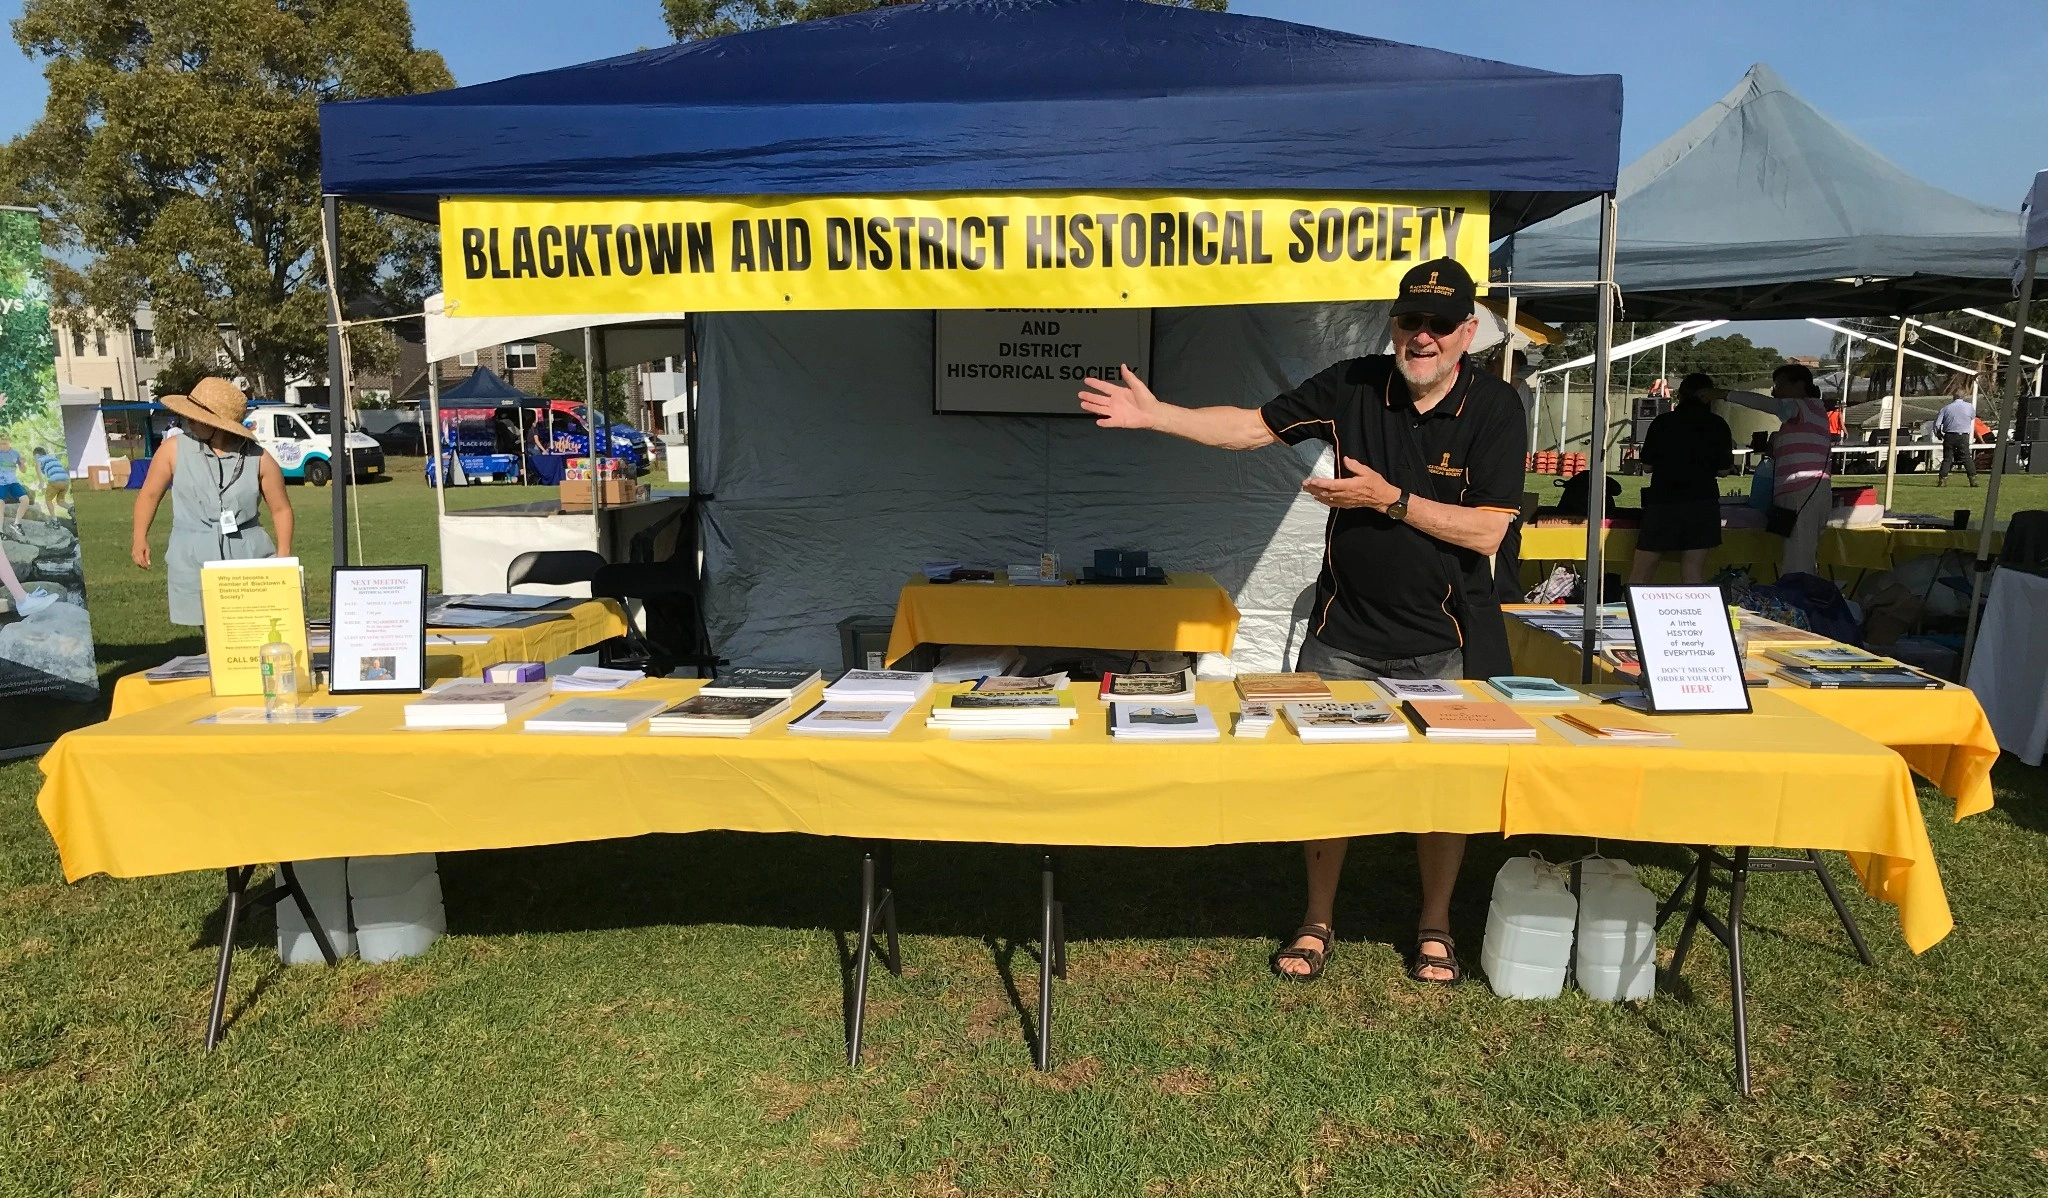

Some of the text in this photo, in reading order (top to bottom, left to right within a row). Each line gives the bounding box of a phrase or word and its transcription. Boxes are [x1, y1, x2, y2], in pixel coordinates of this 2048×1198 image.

[462, 206, 1466, 280] BLACKTOWN AND DISTRICT HISTORICAL SOCIETY
[0, 297, 25, 315] ys
[1020, 320, 1061, 336] AND
[999, 342, 1082, 359] DISTRICT
[947, 363, 1055, 380] HISTORICAL
[372, 578, 409, 586] MEETING
[1641, 592, 1711, 600] COMING SOON
[1658, 608, 1702, 616] DOONSIDE
[1666, 629, 1703, 637] HISTORY
[1670, 639, 1678, 647] of
[1663, 649, 1716, 657] EVERYTHING
[226, 656, 248, 664] CALL
[1687, 666, 1707, 674] MISS
[1680, 684, 1714, 694] HERE
